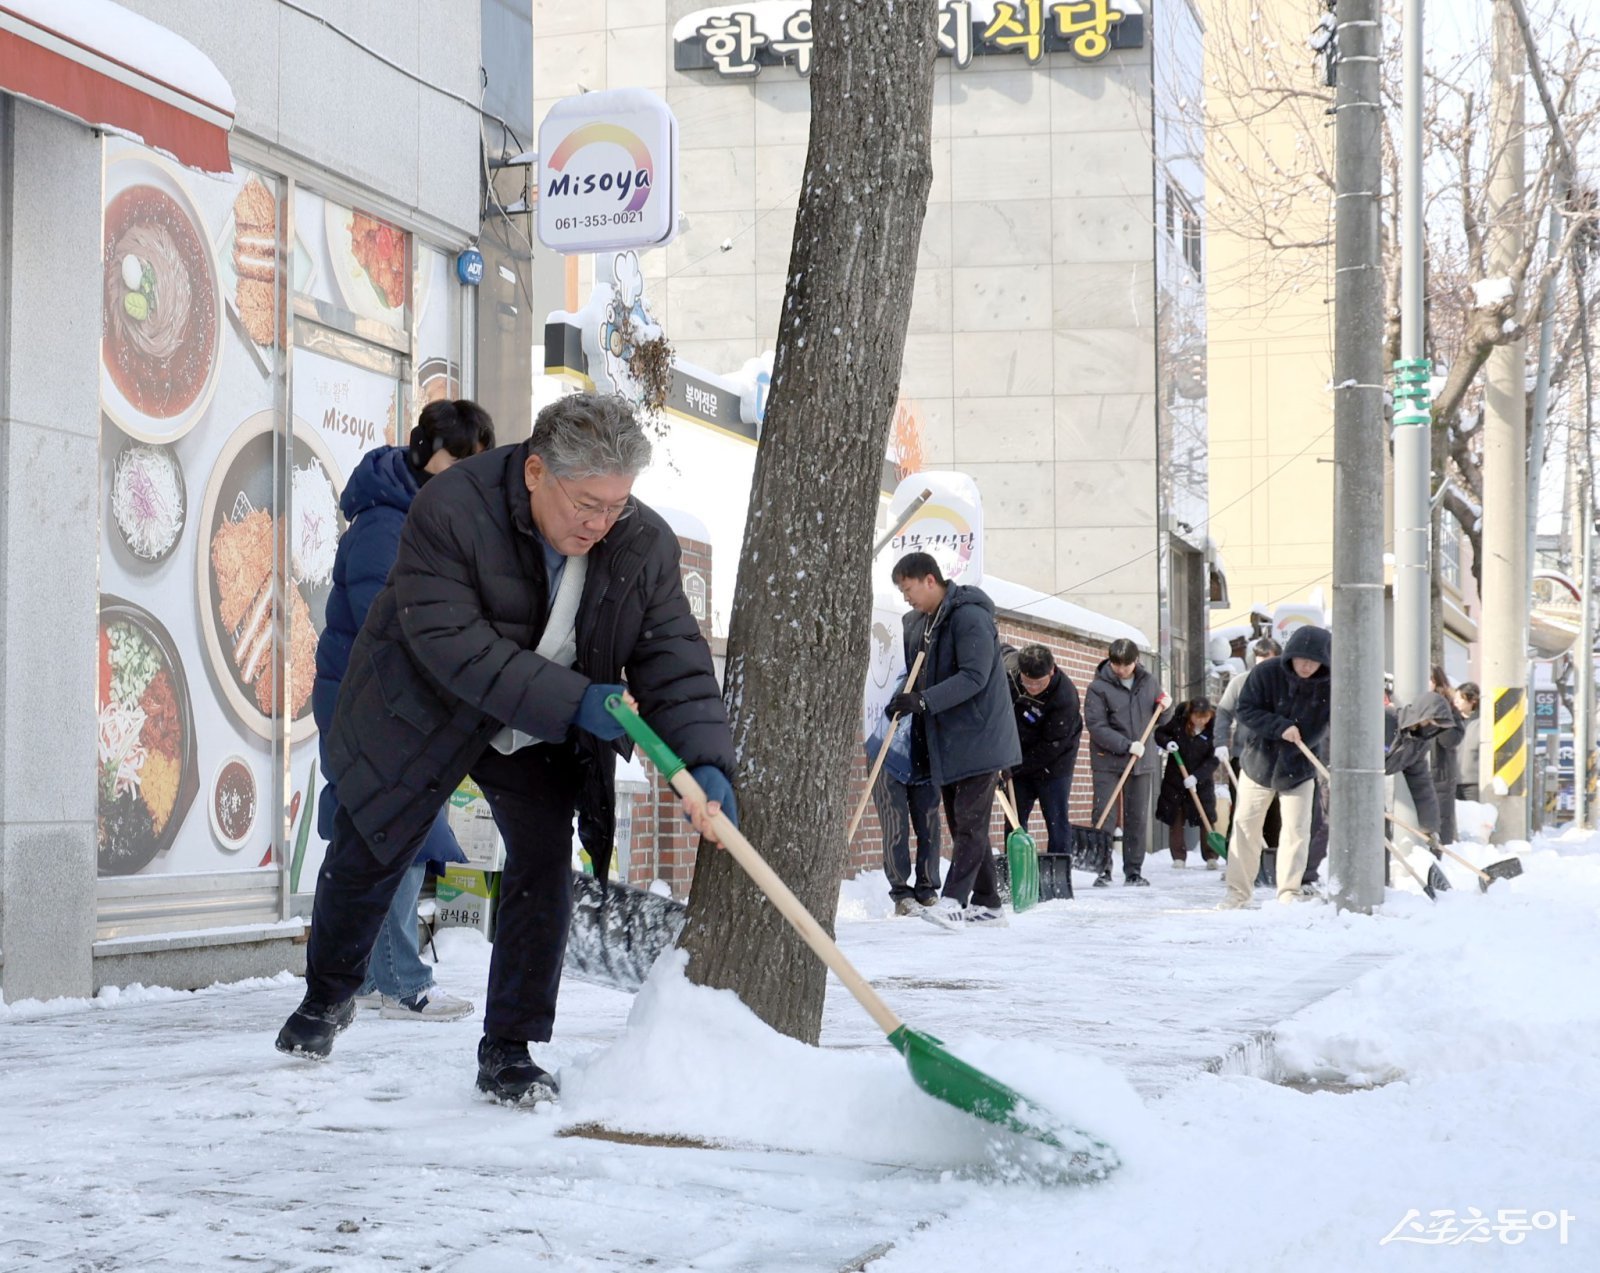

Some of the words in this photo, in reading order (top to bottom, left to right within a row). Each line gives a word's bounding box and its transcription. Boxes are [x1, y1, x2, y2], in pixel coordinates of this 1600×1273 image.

[547, 168, 651, 201] Misoya
[555, 210, 644, 230] 061-353-0021
[322, 407, 376, 450] Misoya
[1535, 693, 1555, 705] GS
[1535, 704, 1554, 716] 25
[440, 907, 481, 925] 콩식용유
